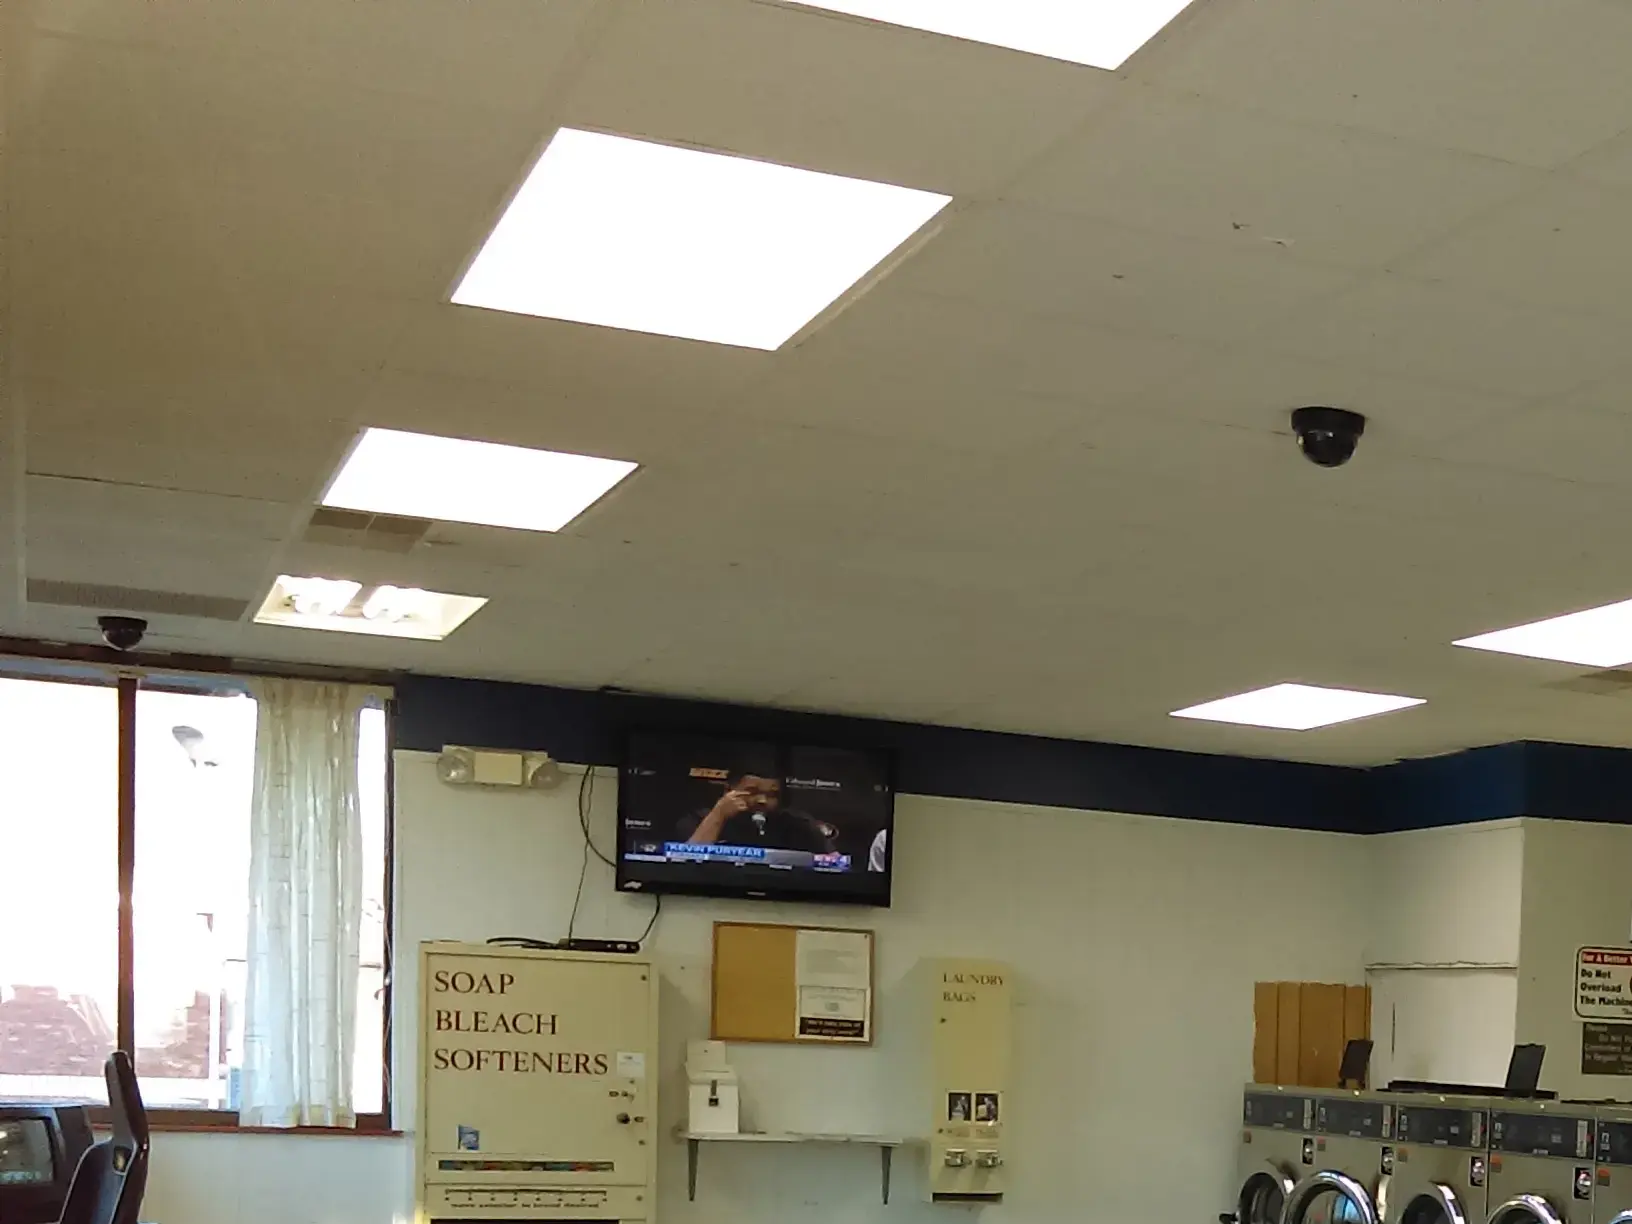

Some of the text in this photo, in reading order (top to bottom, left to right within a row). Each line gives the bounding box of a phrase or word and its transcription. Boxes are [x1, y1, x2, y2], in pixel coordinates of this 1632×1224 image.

[434, 970, 515, 995] SOAP
[435, 1009, 559, 1036] BLEACH
[434, 1048, 609, 1076] SOFTENERS
